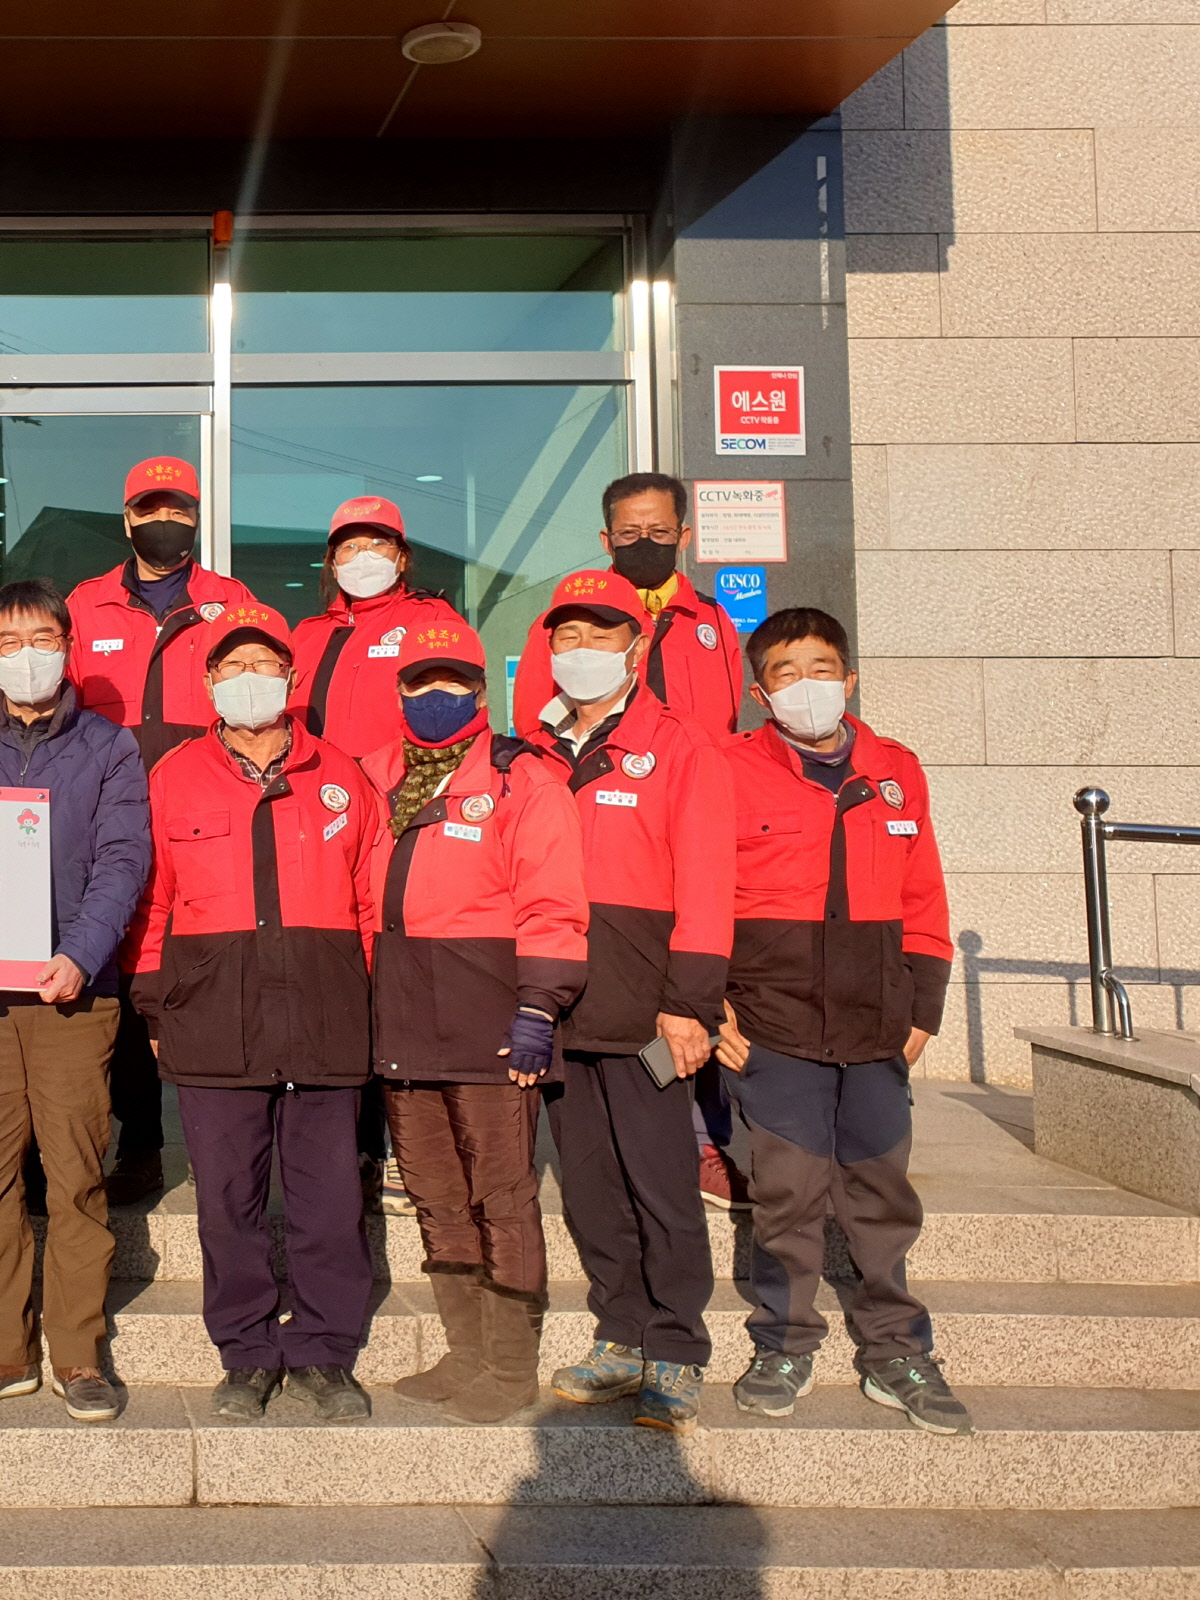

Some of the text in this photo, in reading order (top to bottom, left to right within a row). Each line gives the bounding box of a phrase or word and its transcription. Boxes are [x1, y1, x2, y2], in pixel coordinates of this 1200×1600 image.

[731, 390, 786, 412] 에스원
[740, 416, 759, 424] CCTV
[720, 438, 766, 449] SECOM
[699, 489, 764, 502] CCTV 녹화중
[720, 573, 761, 589] CESCO
